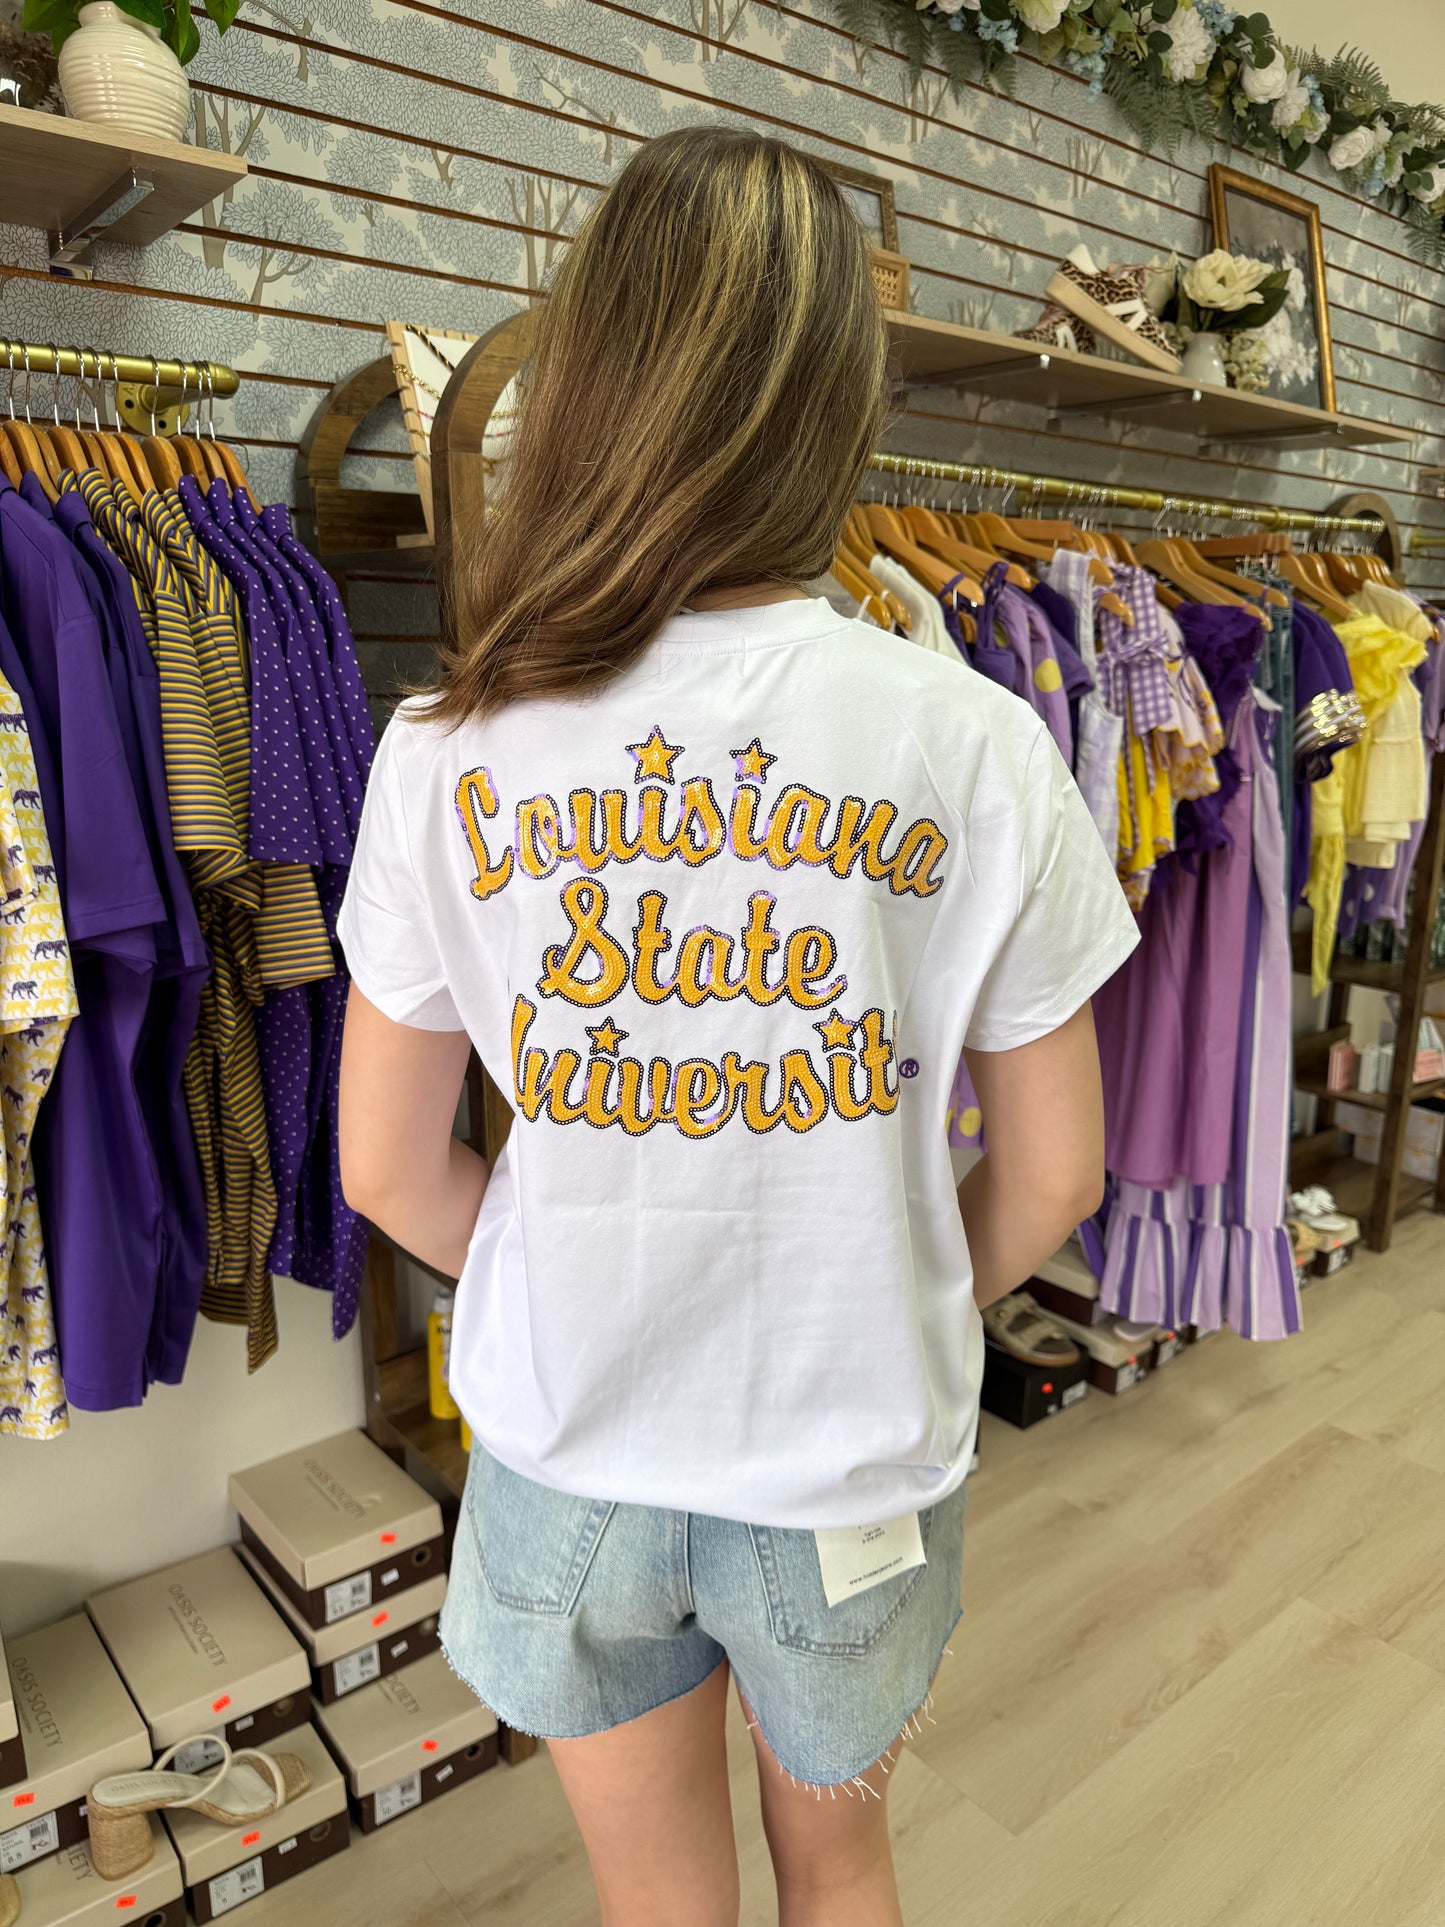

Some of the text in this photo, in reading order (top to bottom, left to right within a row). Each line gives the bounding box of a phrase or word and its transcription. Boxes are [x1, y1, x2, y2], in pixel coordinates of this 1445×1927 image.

[455, 725, 950, 901] Louisiana
[536, 876, 848, 1010] State
[510, 993, 900, 1139] niversit
[12, 1657, 39, 1693] OASIS
[27, 1692, 63, 1748] SOCIETY
[189, 1615, 229, 1667] SOCIETY
